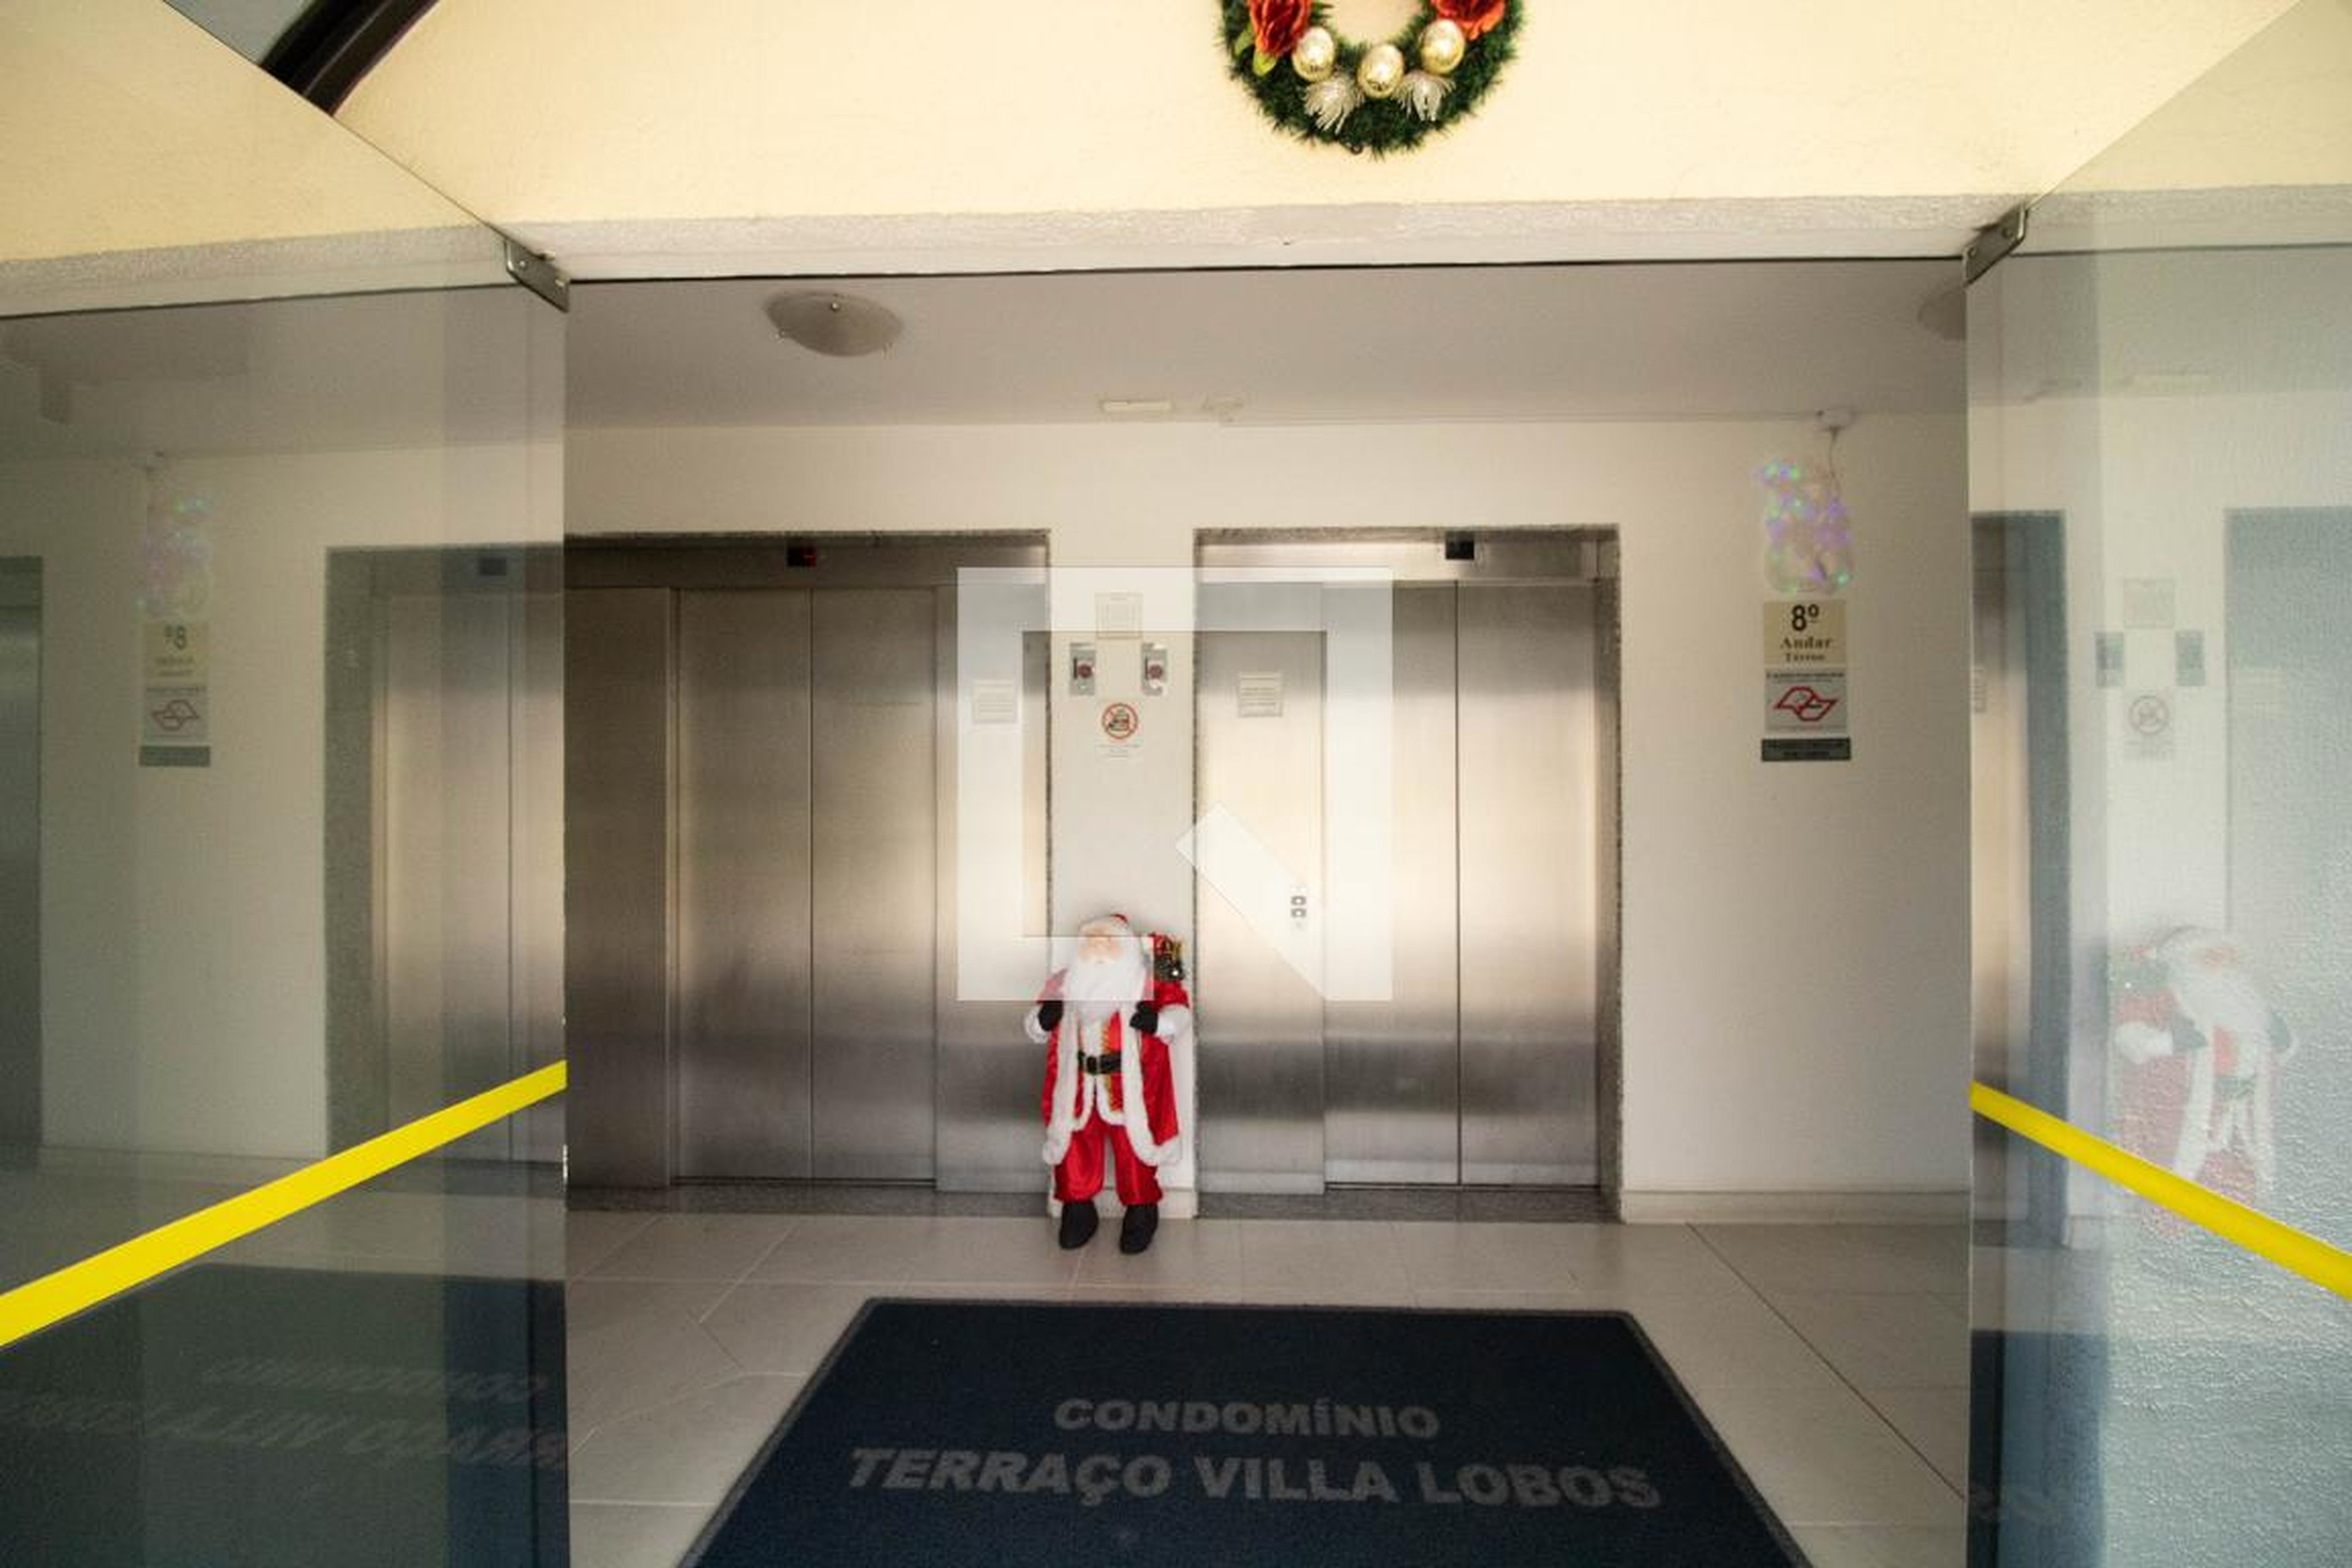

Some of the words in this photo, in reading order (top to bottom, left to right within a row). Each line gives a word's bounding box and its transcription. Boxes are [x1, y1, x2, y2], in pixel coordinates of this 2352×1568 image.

[1780, 636, 1832, 650] Andar
[1054, 1397, 1441, 1439] CONDOMÍNIO
[848, 1447, 1173, 1508] TERRAÇO
[1193, 1453, 1402, 1505] VILLA
[1416, 1459, 1662, 1509] LOBOS
